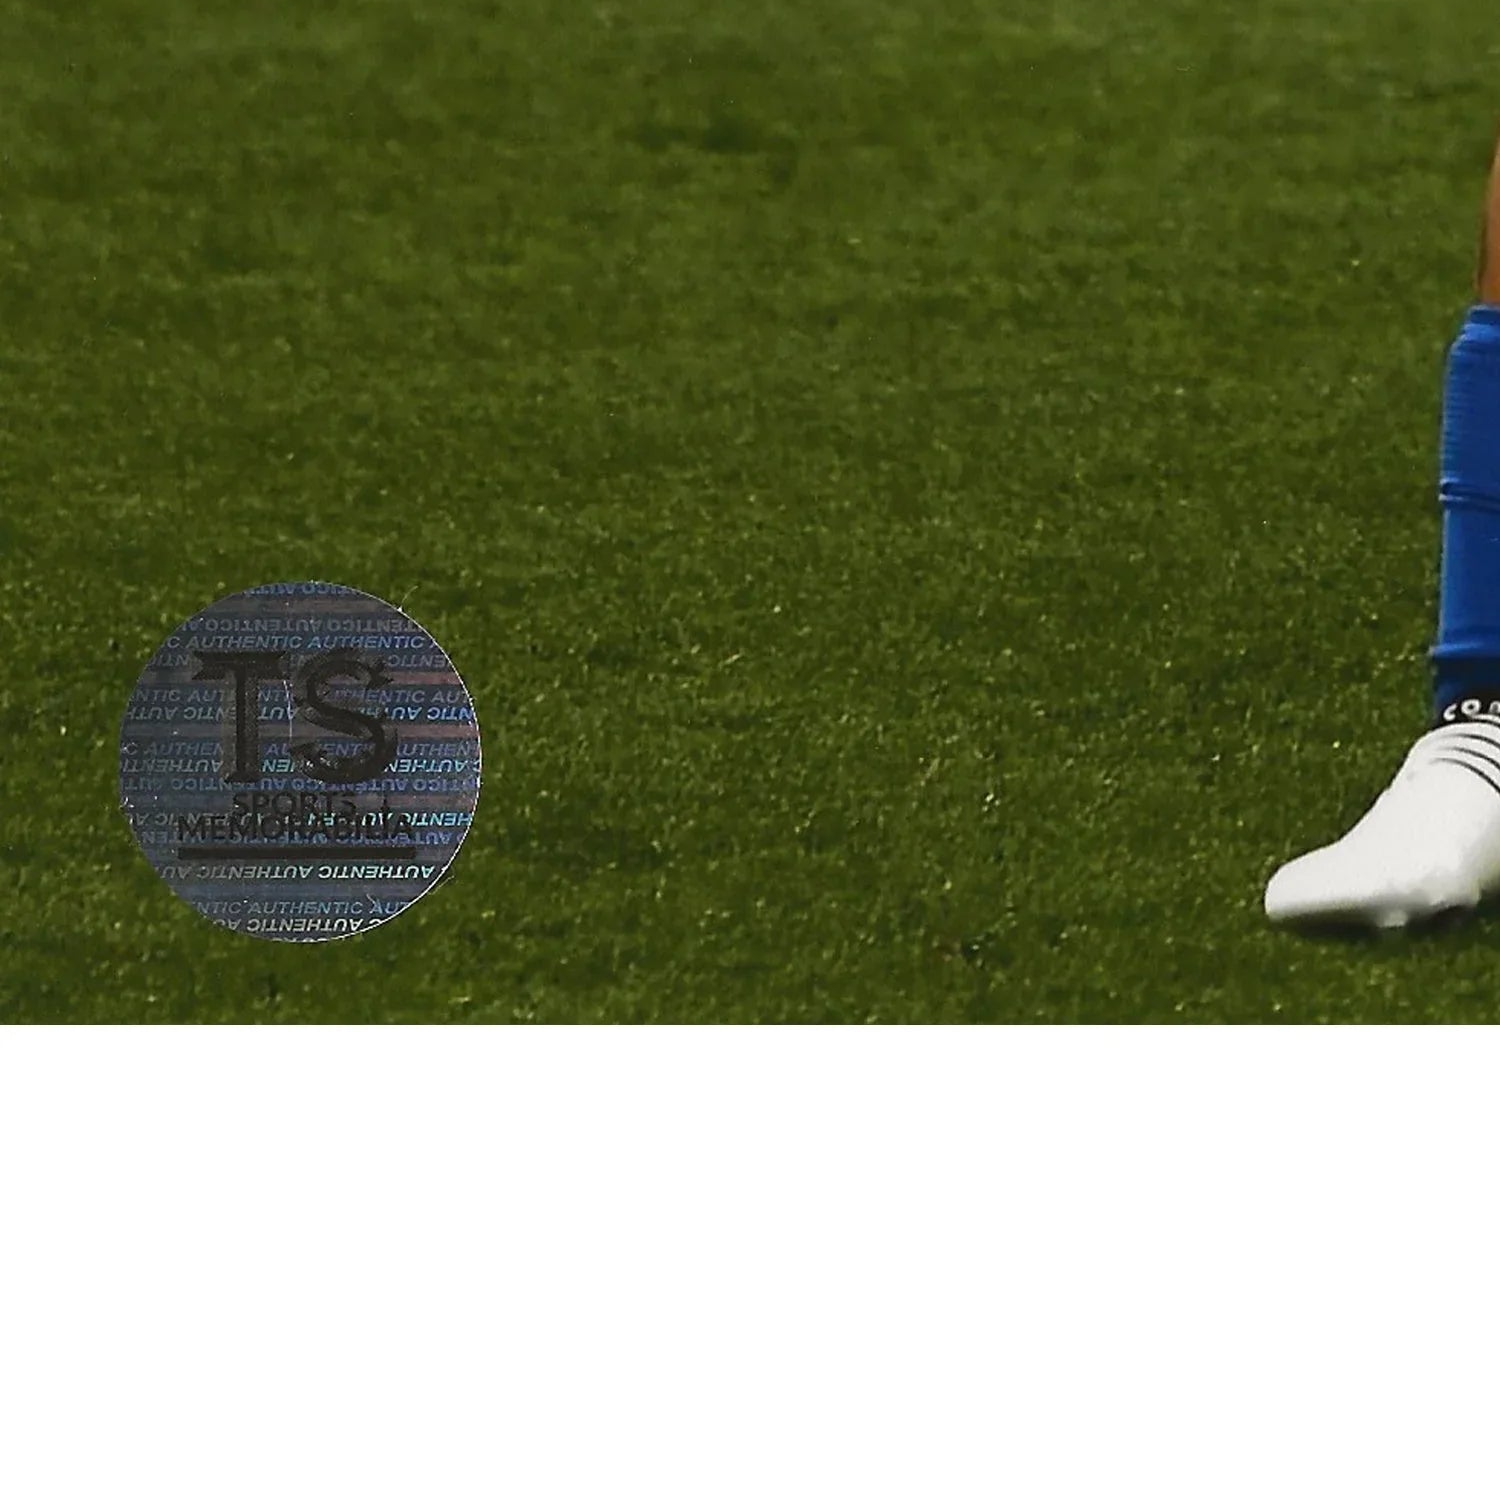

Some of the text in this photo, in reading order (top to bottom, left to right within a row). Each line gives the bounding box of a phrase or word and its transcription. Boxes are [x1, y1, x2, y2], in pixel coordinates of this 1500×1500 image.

[186, 636, 301, 648] AUTHENTIC
[308, 636, 424, 648] AUTHENTIC
[192, 647, 398, 784] TS
[197, 866, 312, 878] AUTHENTIC
[318, 866, 433, 878] AUTHENTIC
[248, 902, 362, 914] AUTHENTIC
[247, 919, 362, 931] AUTHENTIC
